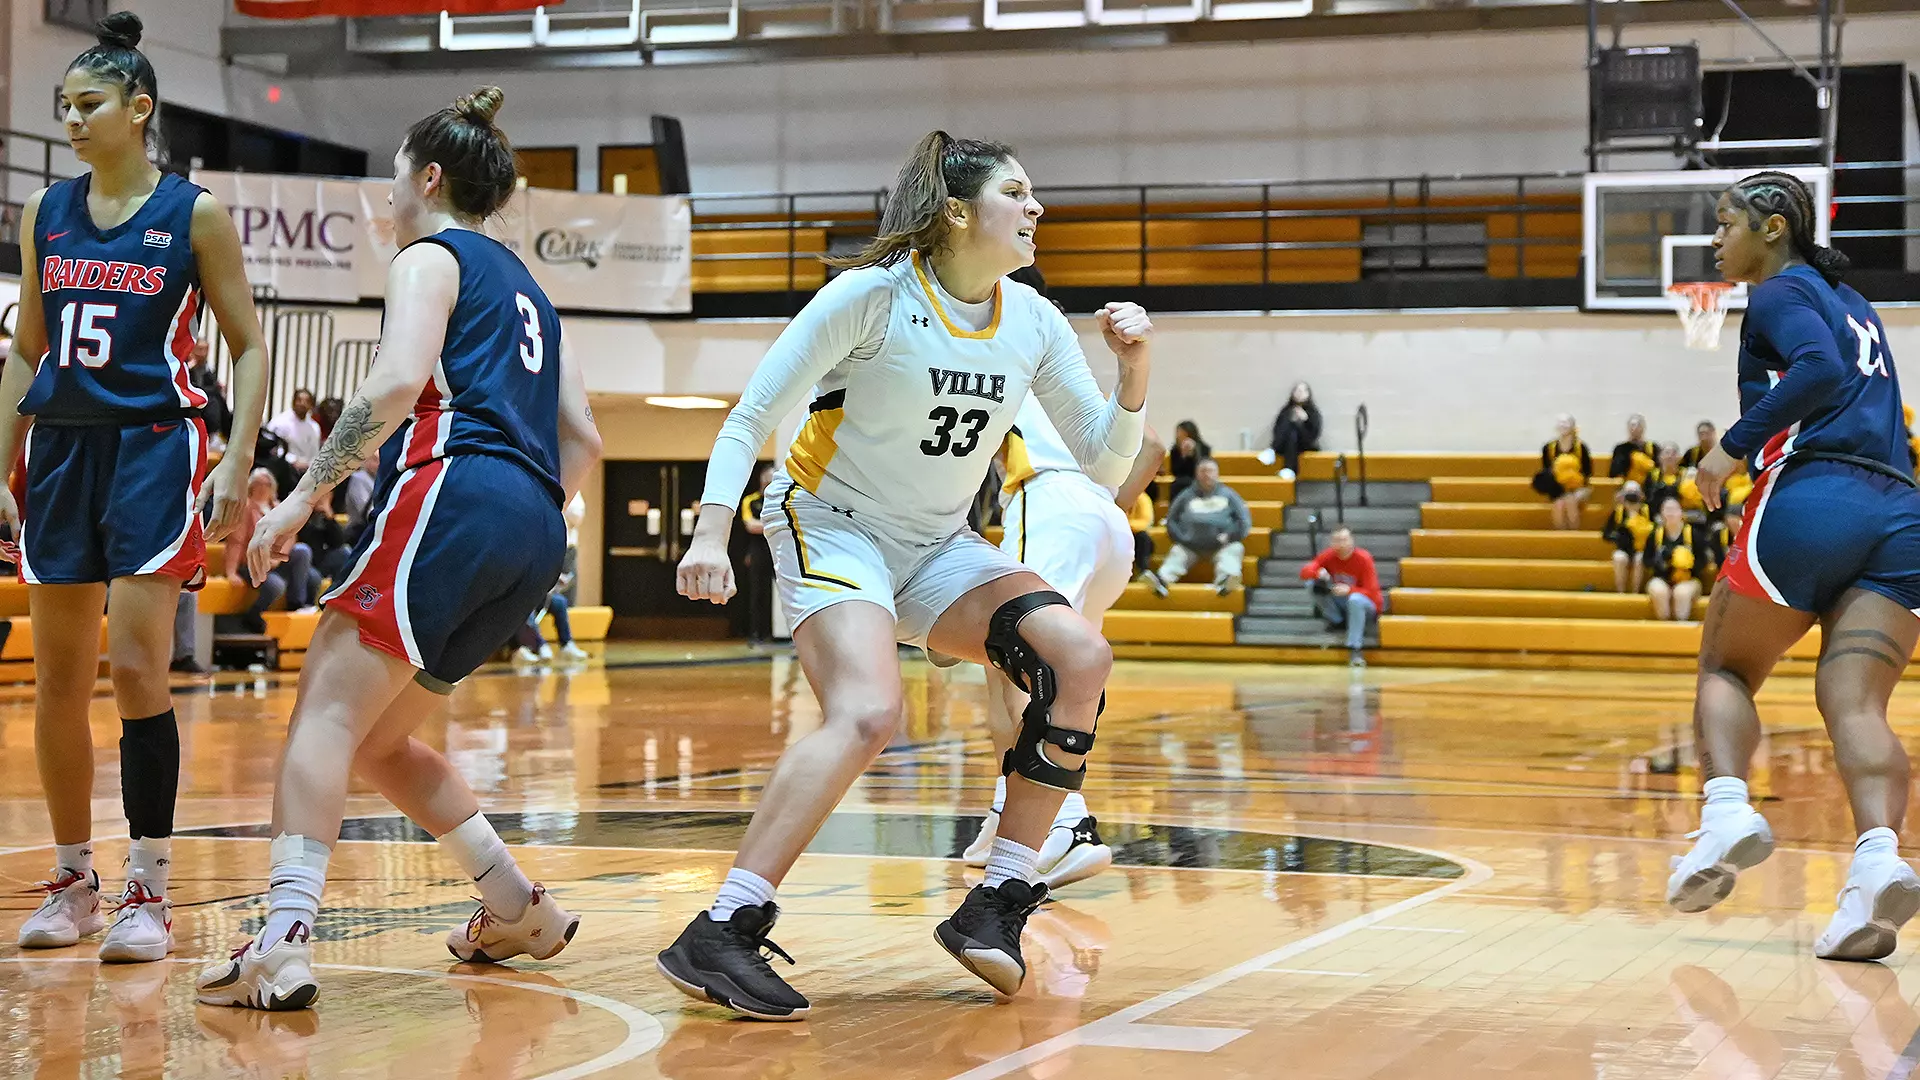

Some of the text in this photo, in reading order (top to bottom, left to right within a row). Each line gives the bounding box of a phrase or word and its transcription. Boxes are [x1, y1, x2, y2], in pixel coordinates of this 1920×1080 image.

[145, 234, 171, 244] PSAC
[42, 255, 167, 295] RAIDERS
[59, 301, 118, 369] 15
[515, 291, 544, 374] 3
[928, 367, 1006, 404] VILLE
[919, 405, 990, 458] 33
